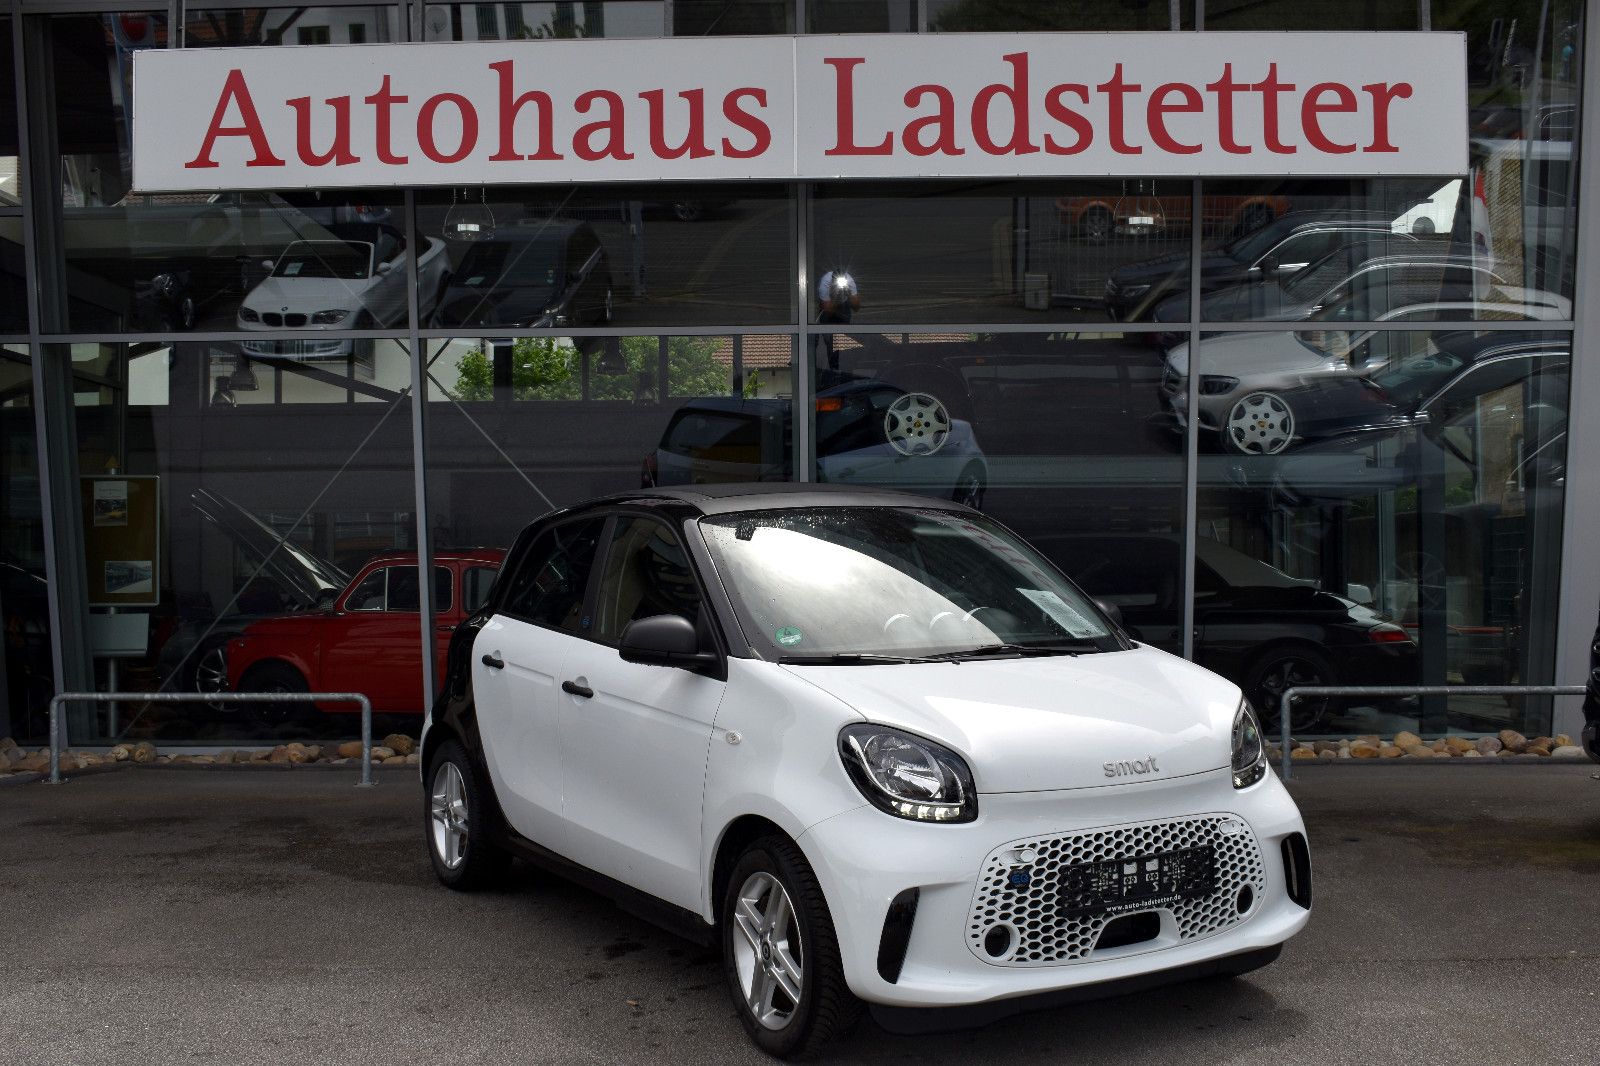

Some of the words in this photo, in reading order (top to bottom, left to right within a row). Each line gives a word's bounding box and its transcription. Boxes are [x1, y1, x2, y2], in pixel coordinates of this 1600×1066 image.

[184, 60, 771, 168] Autohaus
[824, 52, 1412, 156] Ladstetter
[1102, 754, 1160, 778] smart
[1106, 893, 1182, 912] www.auto-ladstetter.de
